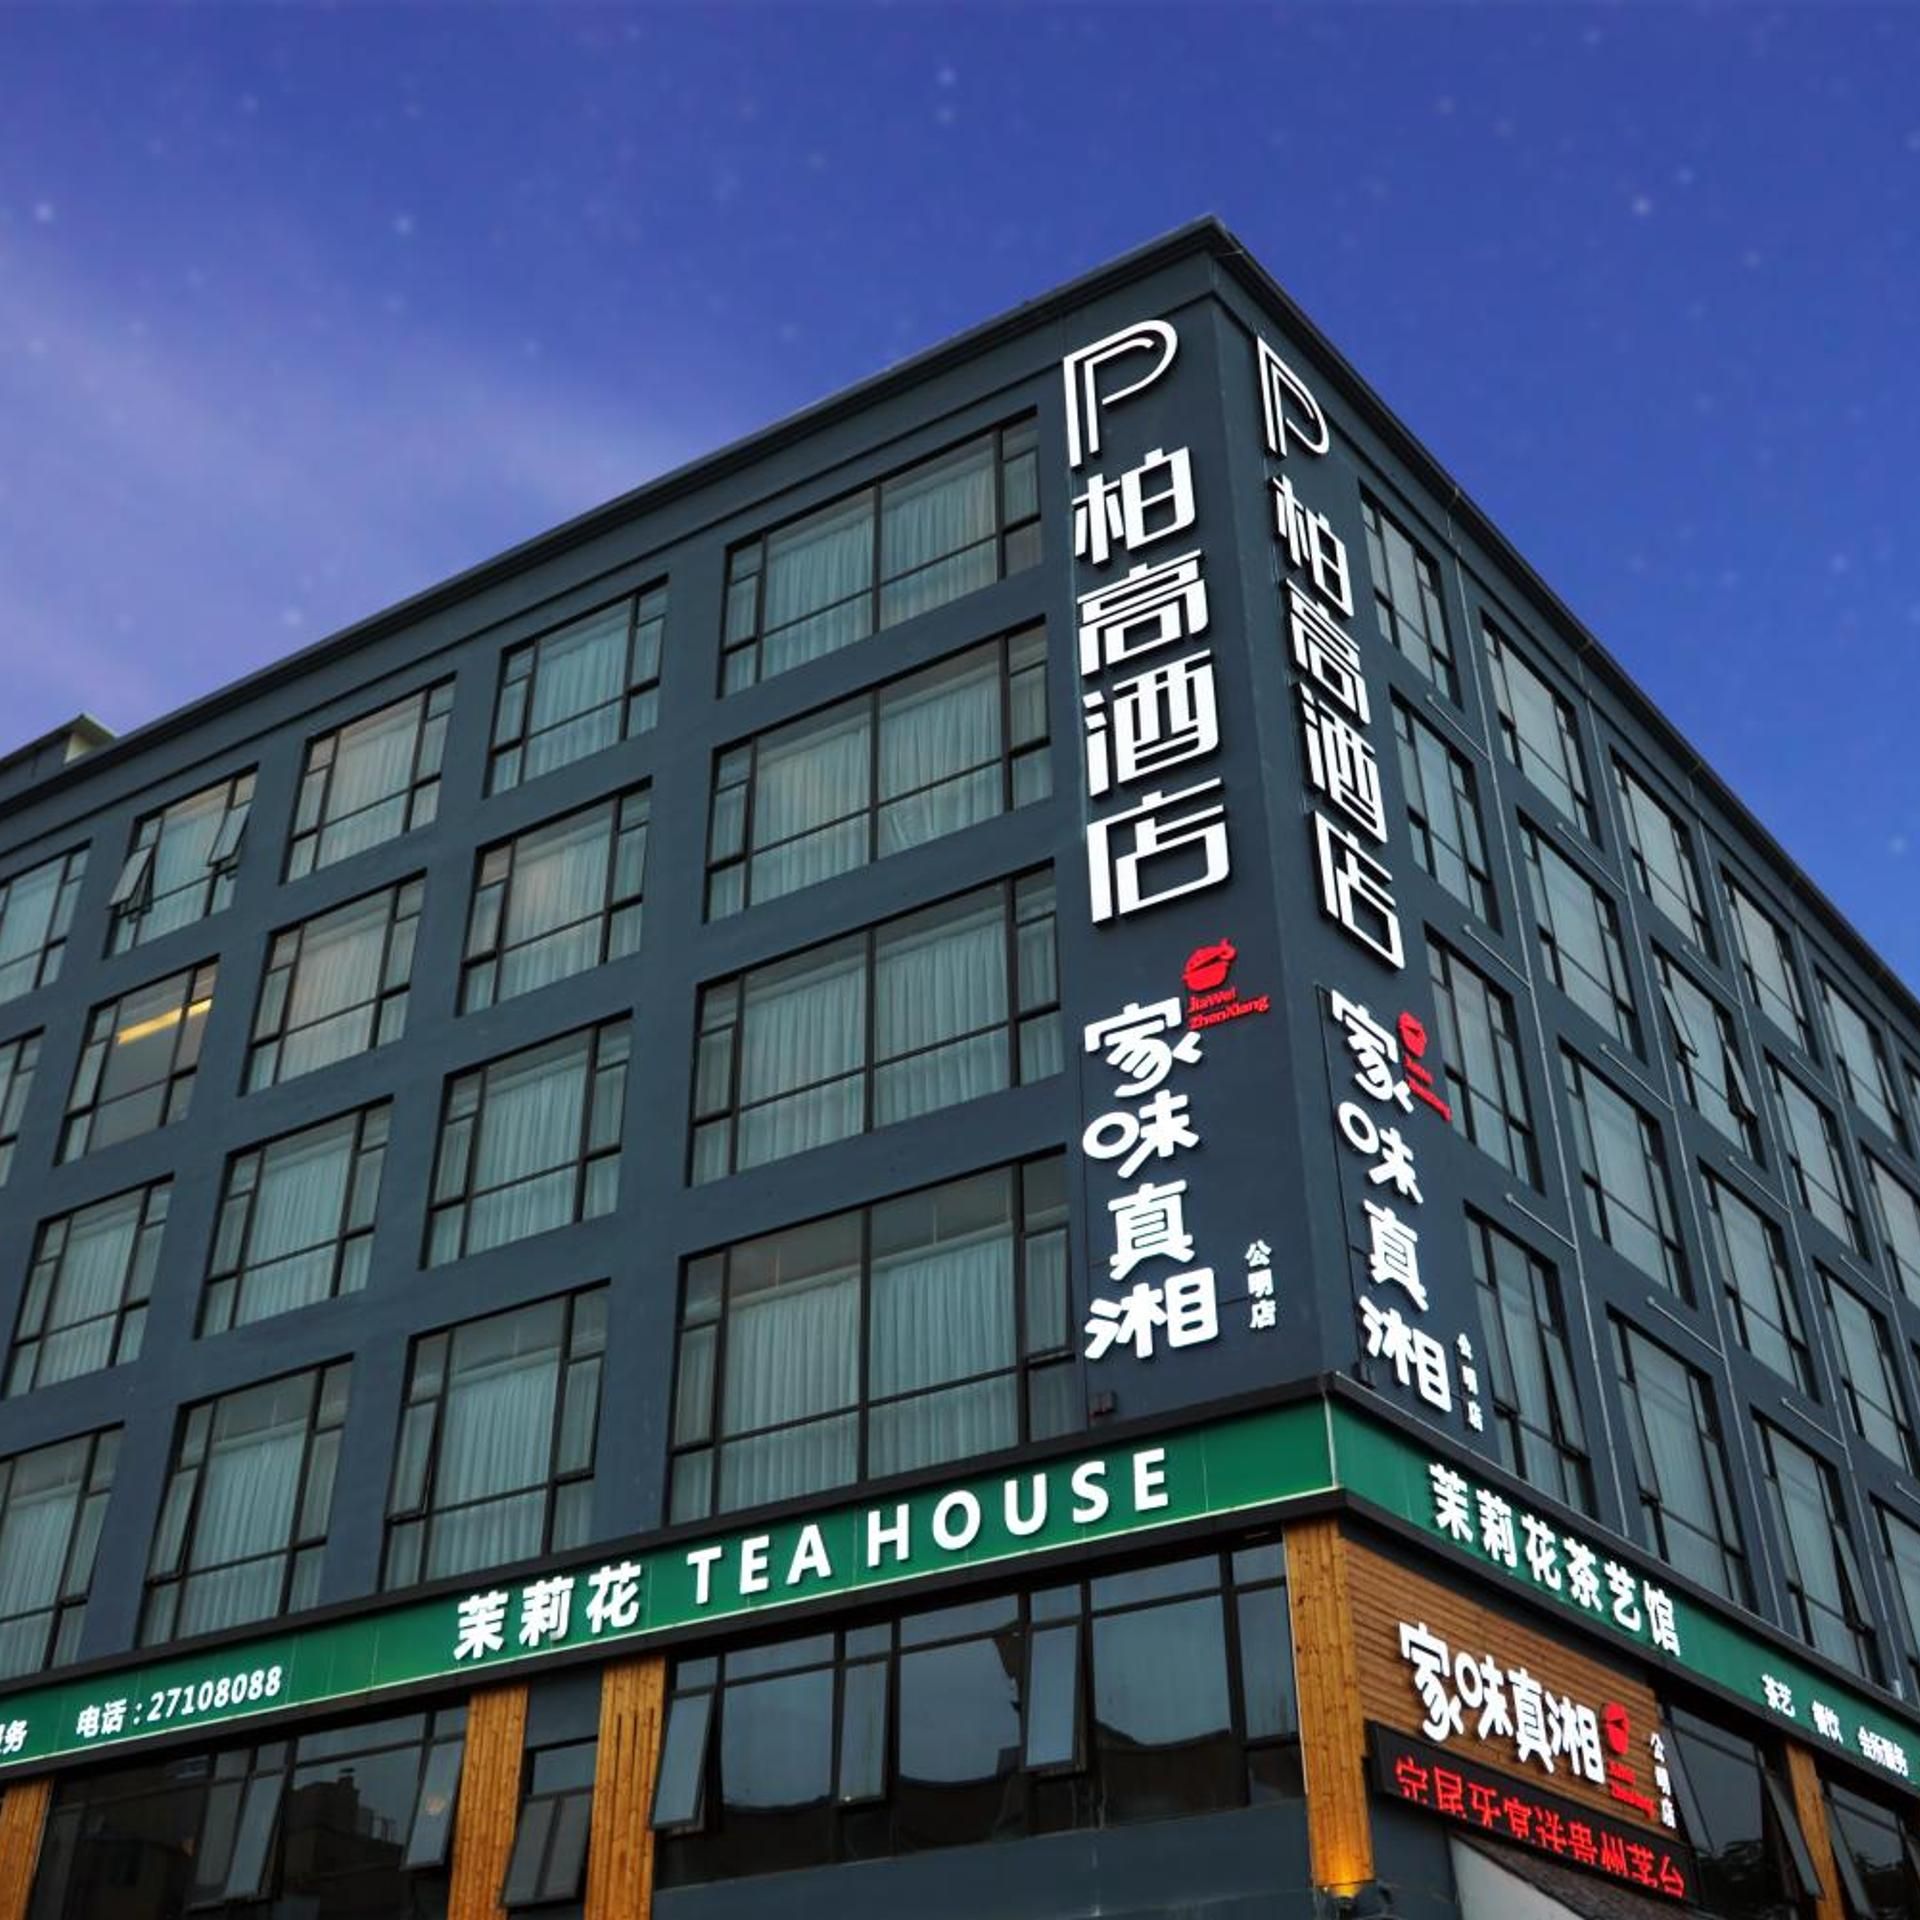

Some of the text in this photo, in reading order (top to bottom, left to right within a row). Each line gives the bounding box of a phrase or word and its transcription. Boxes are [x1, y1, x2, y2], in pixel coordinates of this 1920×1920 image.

[1072, 447, 1229, 922] 柏高酒店
[1271, 475, 1404, 968] 柏高酒店
[1083, 997, 1219, 1359] 家味真湘
[1244, 1240, 1276, 1330] 公明店
[1331, 990, 1452, 1412] 家味真湘
[453, 1449, 1169, 1660] 茉莉花 TEA HOUSE
[1429, 1464, 1681, 1657] 茉莉花茶艺馆
[1399, 1623, 1606, 1784] 家味真湘
